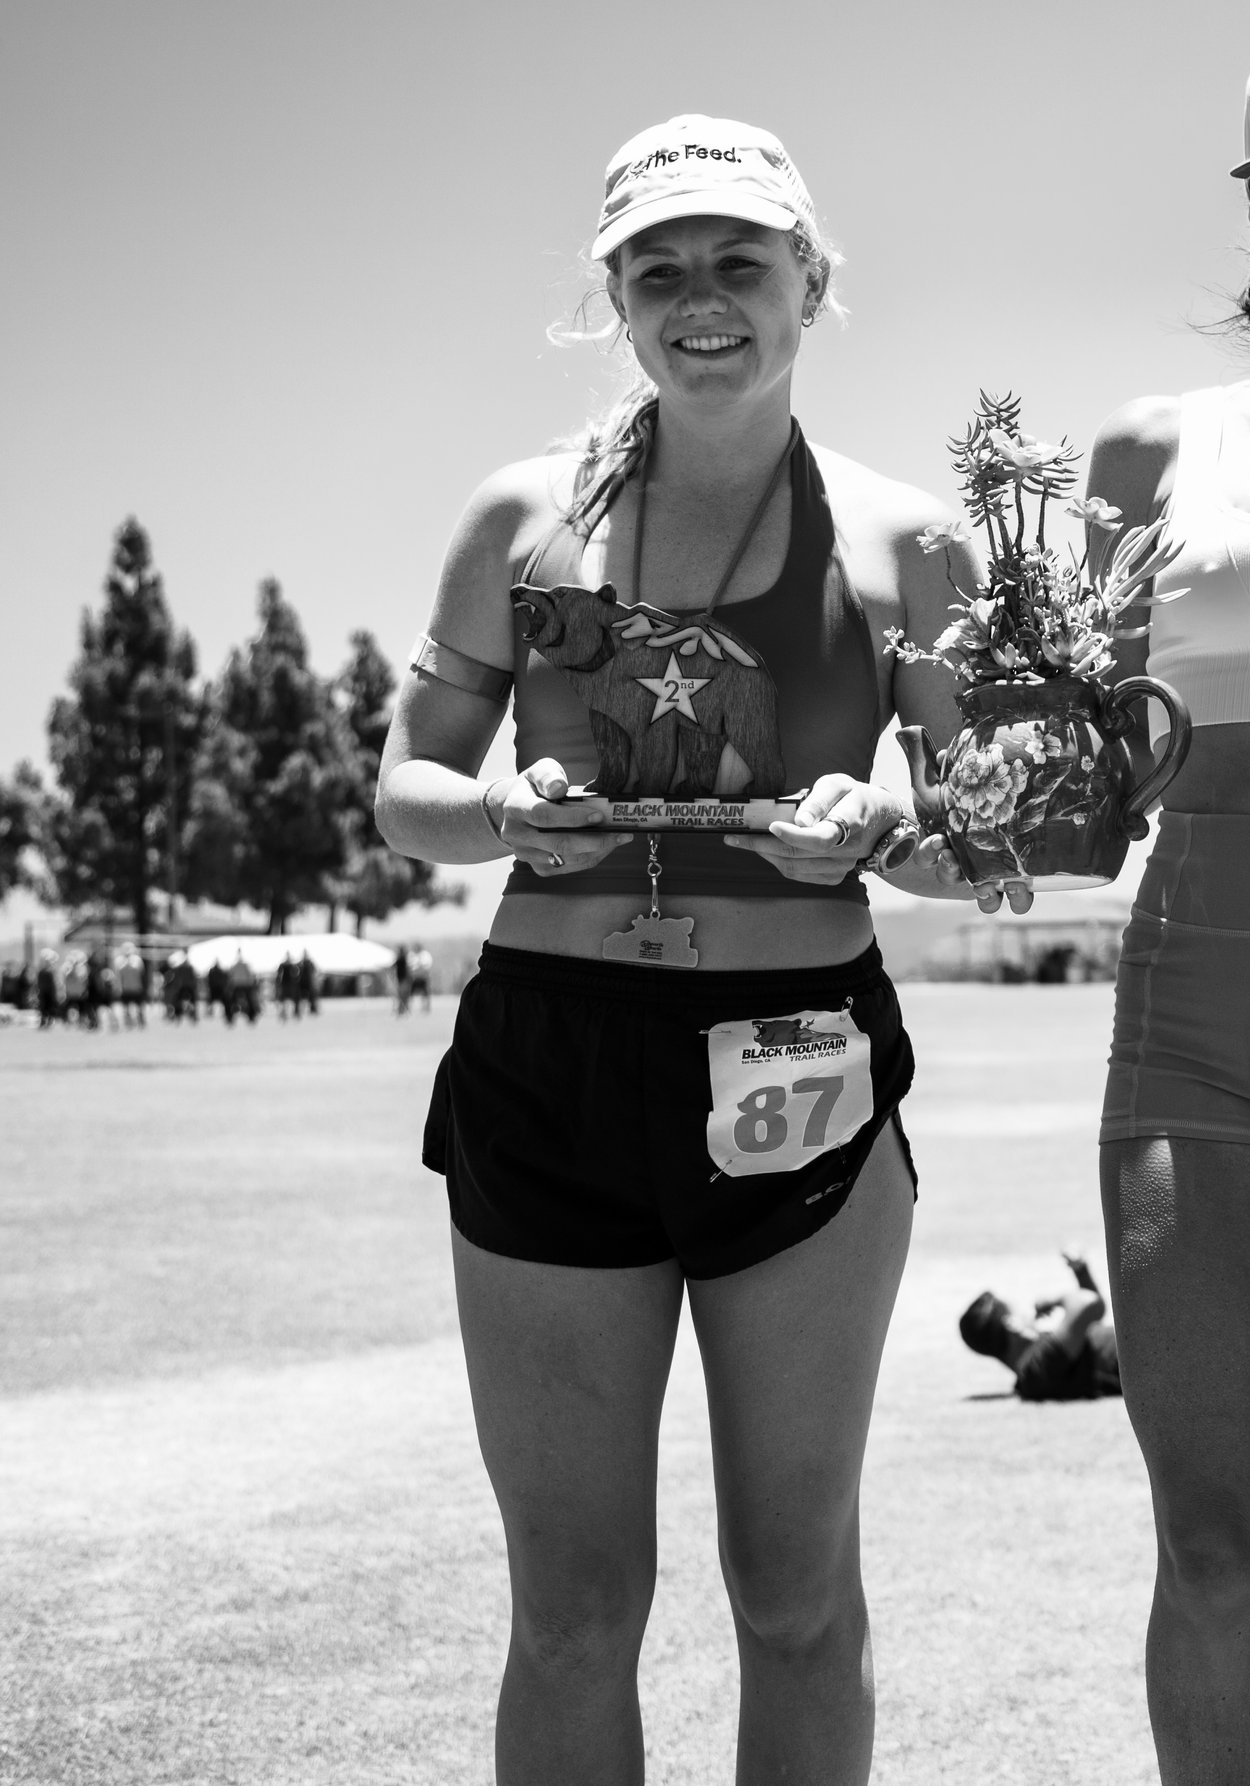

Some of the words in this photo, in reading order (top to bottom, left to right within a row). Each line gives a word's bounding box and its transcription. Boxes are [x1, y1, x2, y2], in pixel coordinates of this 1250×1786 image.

[684, 144, 742, 163] Feed.
[664, 679, 695, 702] 2nd
[612, 804, 663, 817] BLACK
[665, 805, 745, 818] MOUNTAIN
[671, 817, 704, 826] TRAIL
[707, 817, 744, 826] RACES
[741, 1046, 784, 1060] BLACK
[784, 1037, 848, 1056] MOUNTAIN
[789, 1054, 816, 1063] TRAIL
[817, 1048, 847, 1059] RACES
[733, 1075, 845, 1154] 87
